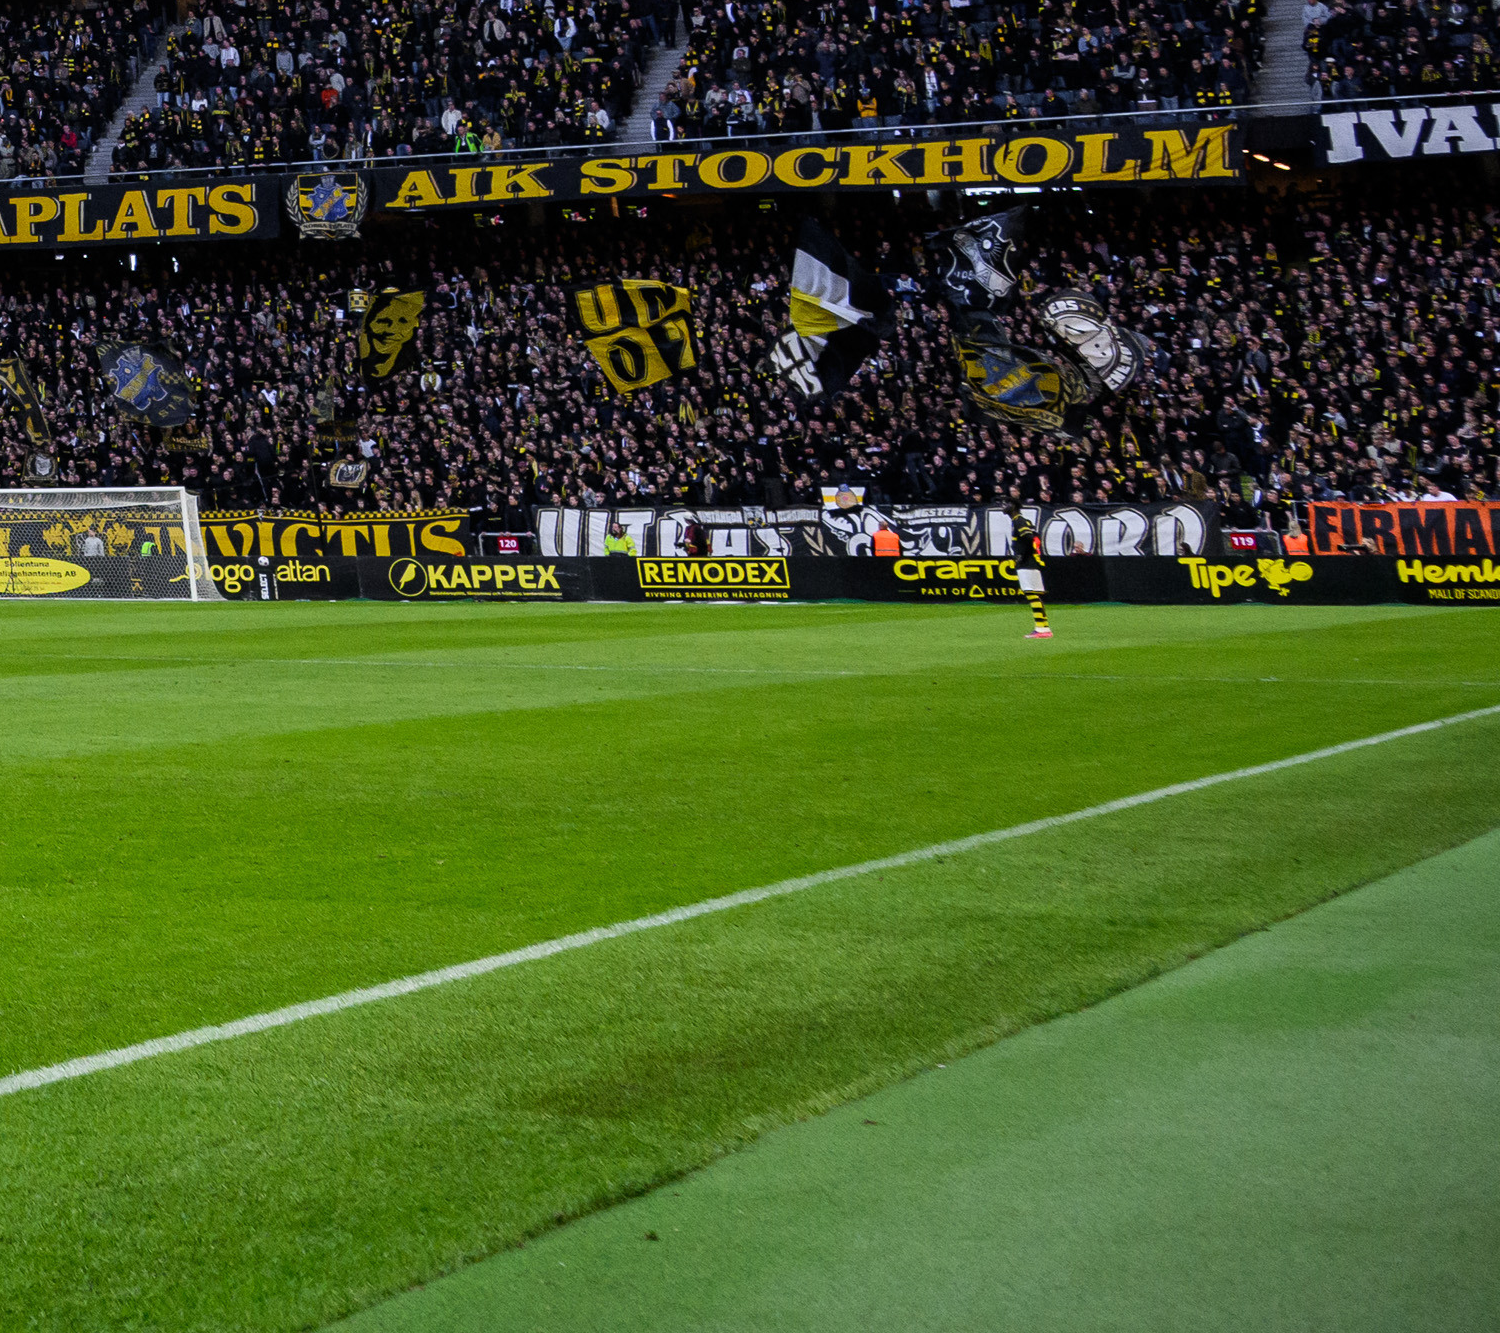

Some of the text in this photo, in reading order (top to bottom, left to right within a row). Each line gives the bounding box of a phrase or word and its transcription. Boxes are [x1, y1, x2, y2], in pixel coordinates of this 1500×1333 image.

[1320, 105, 1500, 164] IVA
[384, 123, 1240, 209] AIK STOCKHOLM
[1231, 536, 1255, 547] 119
[1314, 507, 1500, 556] FIRMA
[499, 539, 517, 549] 120
[428, 564, 560, 589] KAPPEX
[644, 562, 784, 584] REMODEX
[1177, 557, 1257, 598] Tipe
[645, 590, 788, 599] RIVNING SANERING HÅLTAGNING
[921, 588, 949, 597] PART
[951, 588, 966, 597] OF
[1428, 589, 1454, 599] MALL
[1455, 589, 1466, 599] OF
